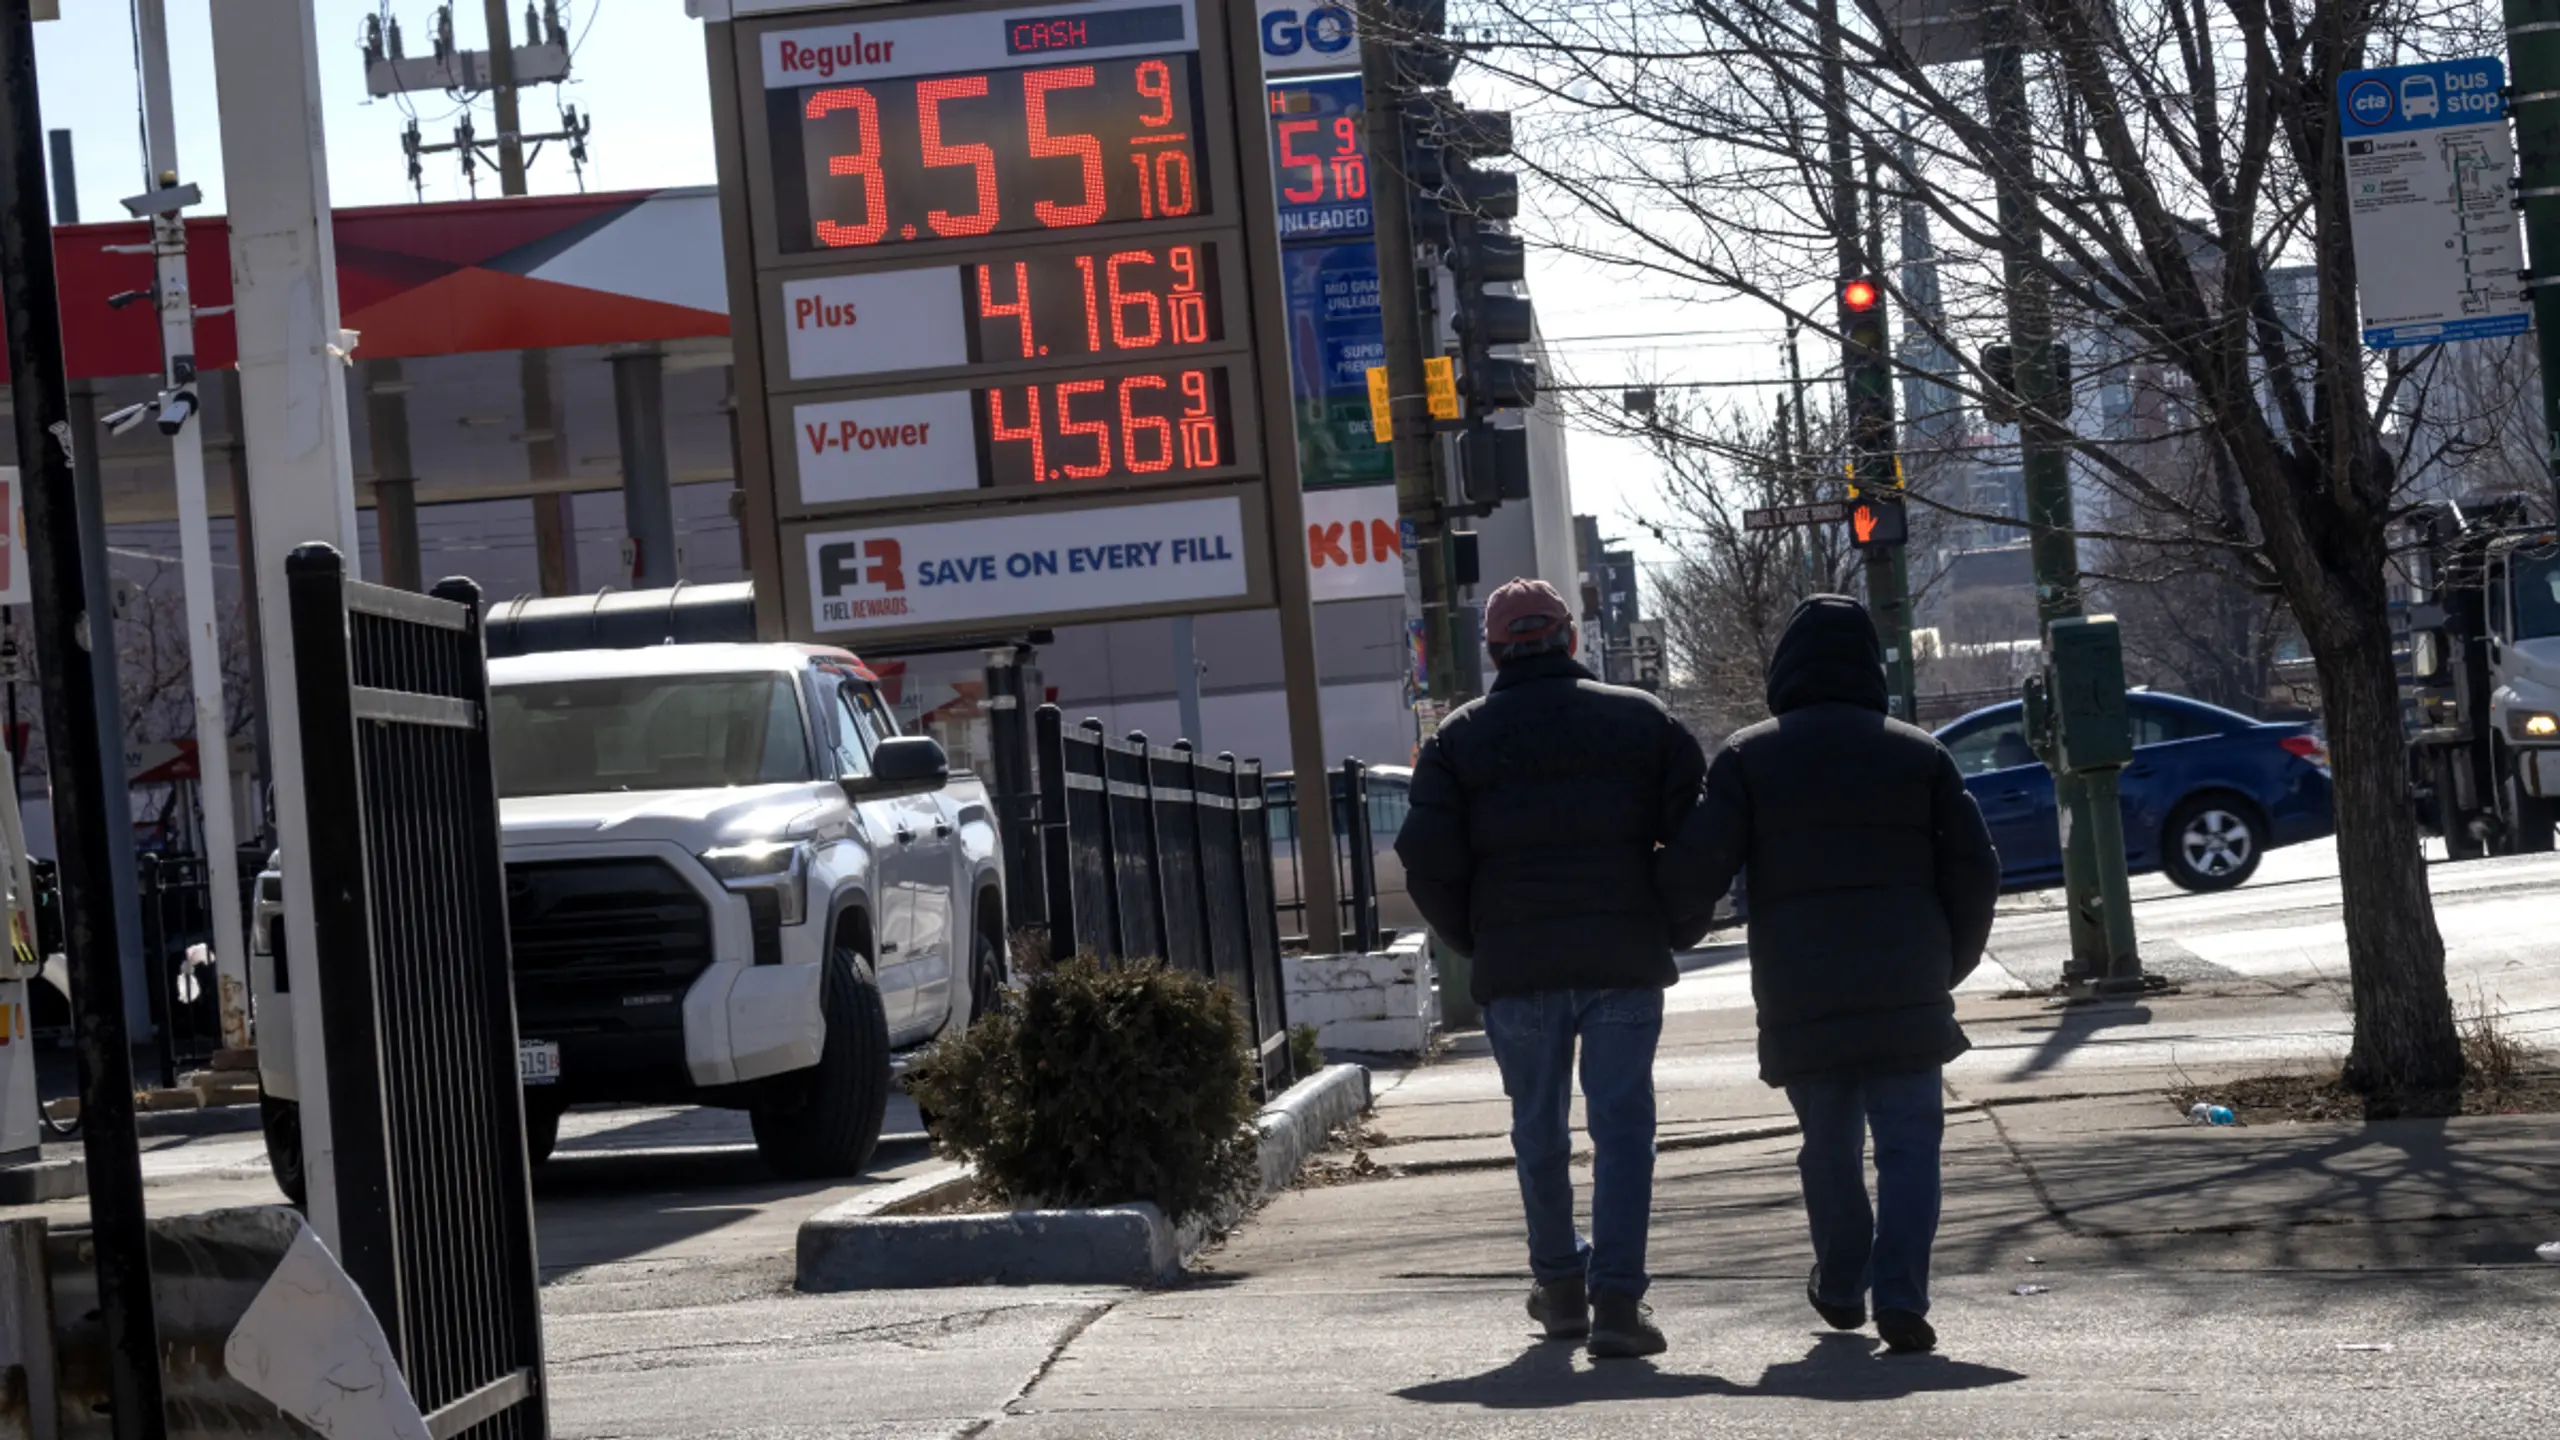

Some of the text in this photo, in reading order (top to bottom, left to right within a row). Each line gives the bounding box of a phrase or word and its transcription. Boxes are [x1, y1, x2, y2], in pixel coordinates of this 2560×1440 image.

[1013, 21, 1086, 50] CASH
[1261, 8, 1353, 56] GO
[781, 32, 895, 77] Regular
[2444, 71, 2489, 90] bus
[2356, 93, 2387, 111] cta
[2447, 91, 2499, 114] stop
[805, 66, 1107, 248] 3.55
[796, 294, 857, 330] Plus
[977, 249, 1162, 358] 4.16
[1343, 343, 1384, 358] SUPER
[805, 420, 930, 455] V-Power
[989, 375, 1173, 482] 4.56
[918, 535, 1232, 587] SAVE ON EVERY FILL
[823, 596, 908, 621] FUEL REWARDS
